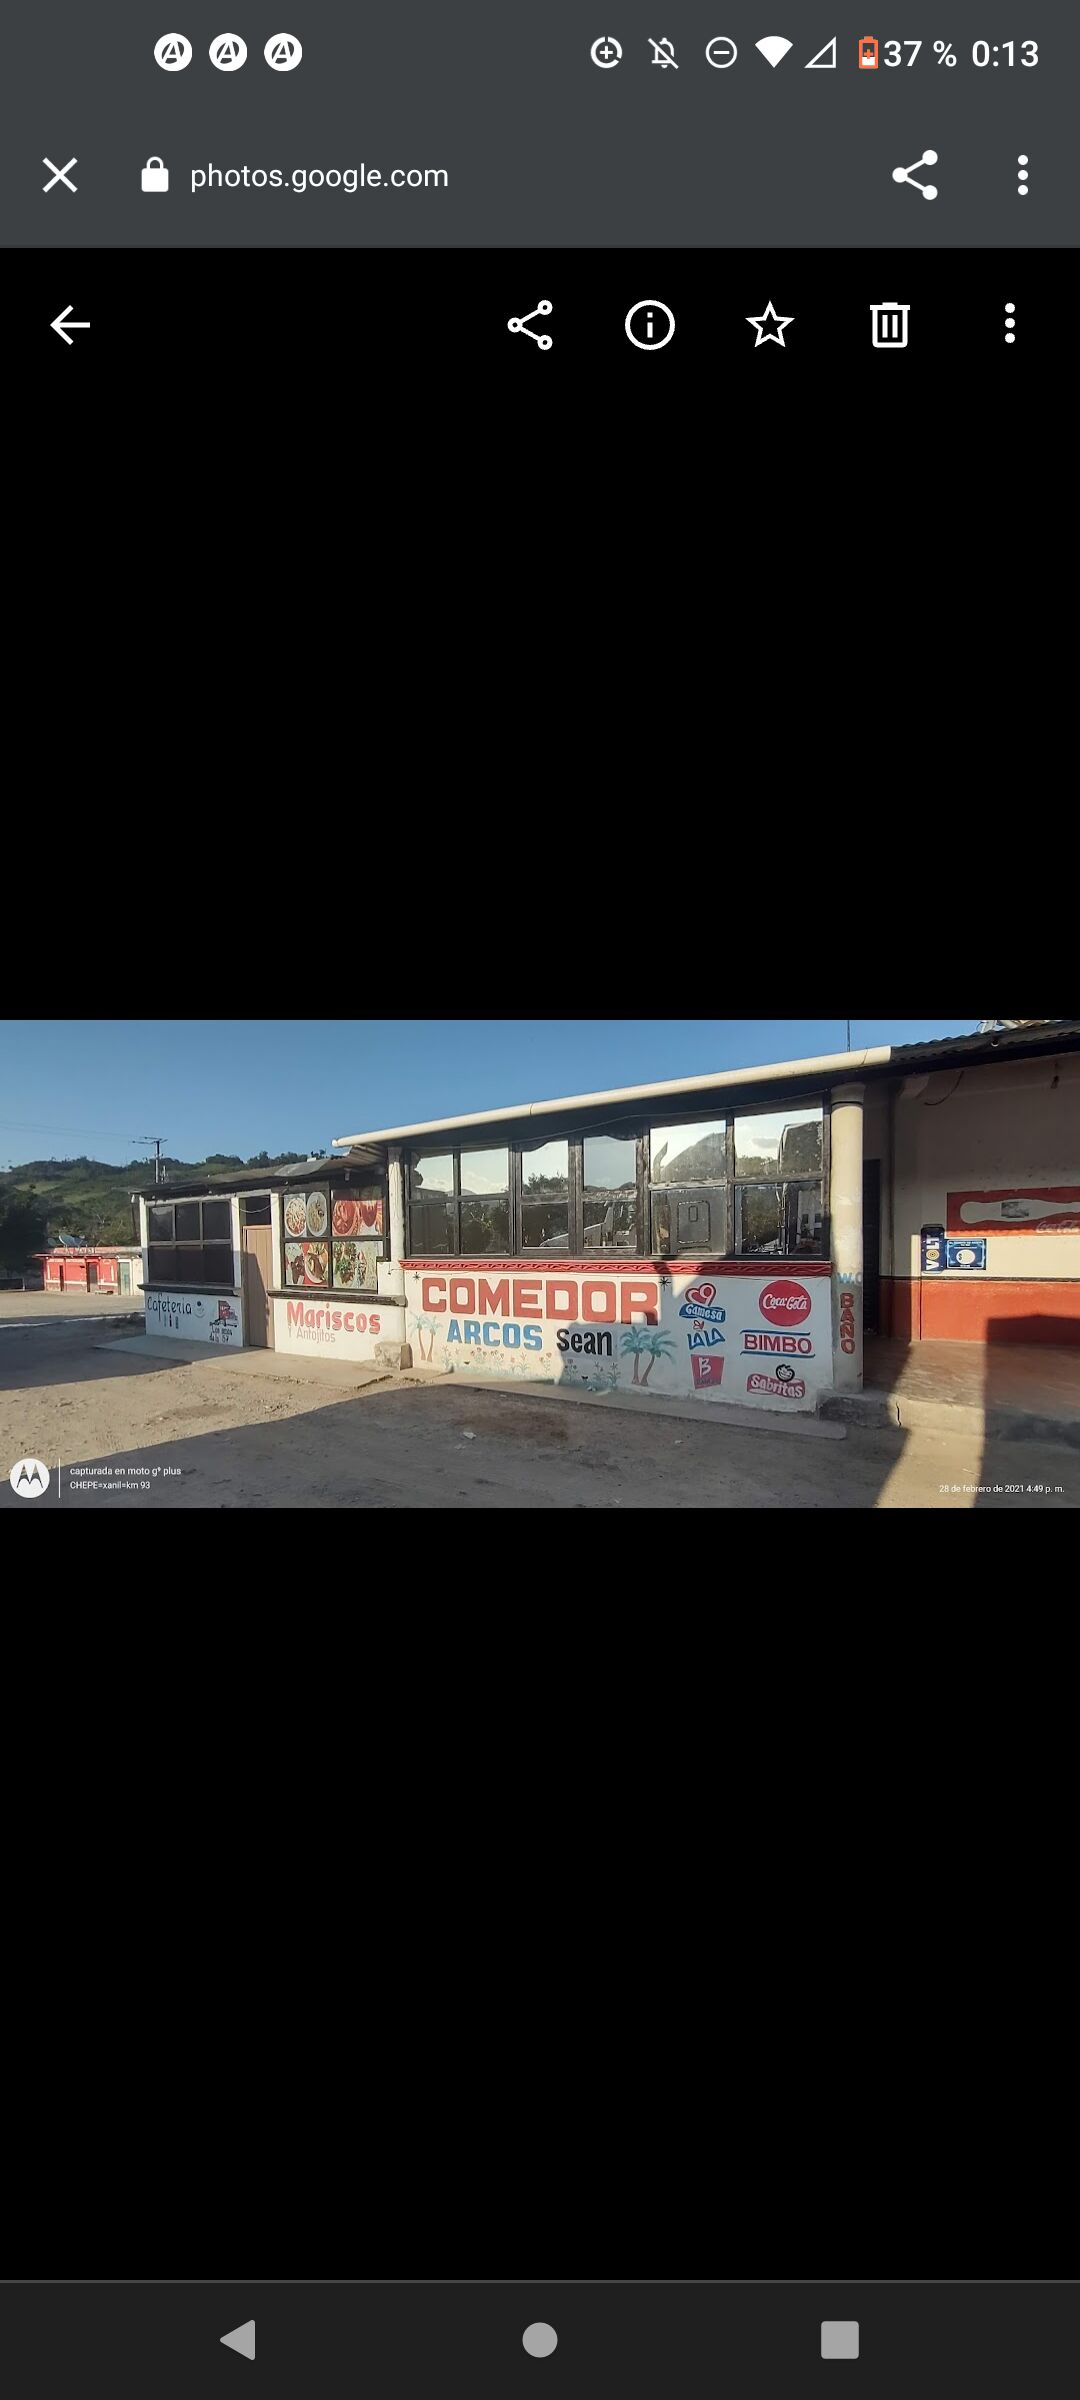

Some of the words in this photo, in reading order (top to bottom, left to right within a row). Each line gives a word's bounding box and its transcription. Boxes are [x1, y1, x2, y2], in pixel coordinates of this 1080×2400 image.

[883, 40, 923, 68] 37
[932, 40, 957, 68] %
[971, 40, 1039, 68] 0:13
[190, 161, 450, 193] photos.google.com
[421, 1277, 659, 1326] COMEDOR
[685, 1304, 723, 1321] Gamesa
[286, 1301, 381, 1335] Mariscos
[296, 1327, 336, 1344] Antojitos
[446, 1319, 543, 1351] ARCOS
[687, 1328, 726, 1350] LALA
[744, 1334, 813, 1354] BIMBO
[750, 1374, 803, 1398] Sabritas
